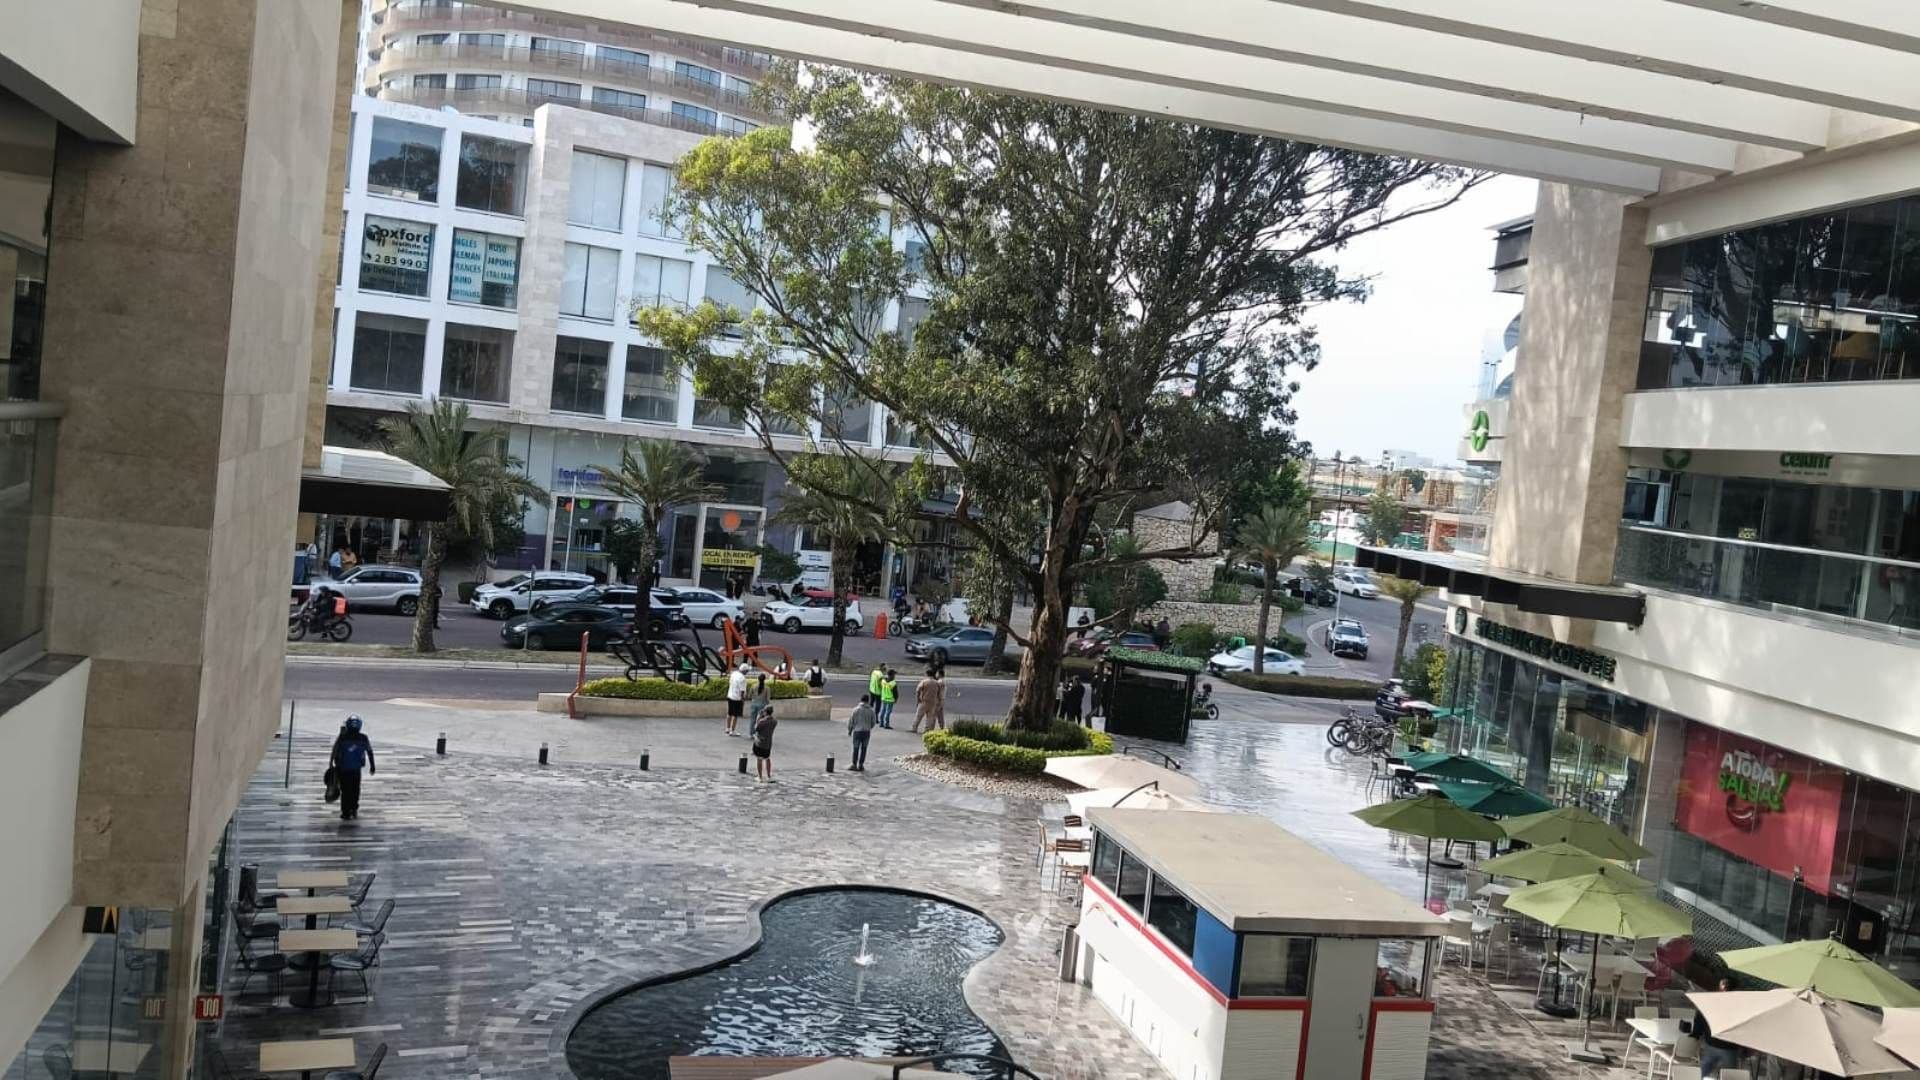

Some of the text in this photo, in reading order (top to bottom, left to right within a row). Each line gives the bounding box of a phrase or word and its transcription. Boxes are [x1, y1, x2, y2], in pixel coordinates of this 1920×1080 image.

[380, 228, 432, 244] oxford
[456, 238, 477, 248] NGLES
[375, 254, 381, 262] 2
[384, 256, 397, 265] 83
[456, 250, 480, 261] LEMAN
[455, 263, 481, 273] RANCES
[1552, 640, 1617, 682] COFFEE
